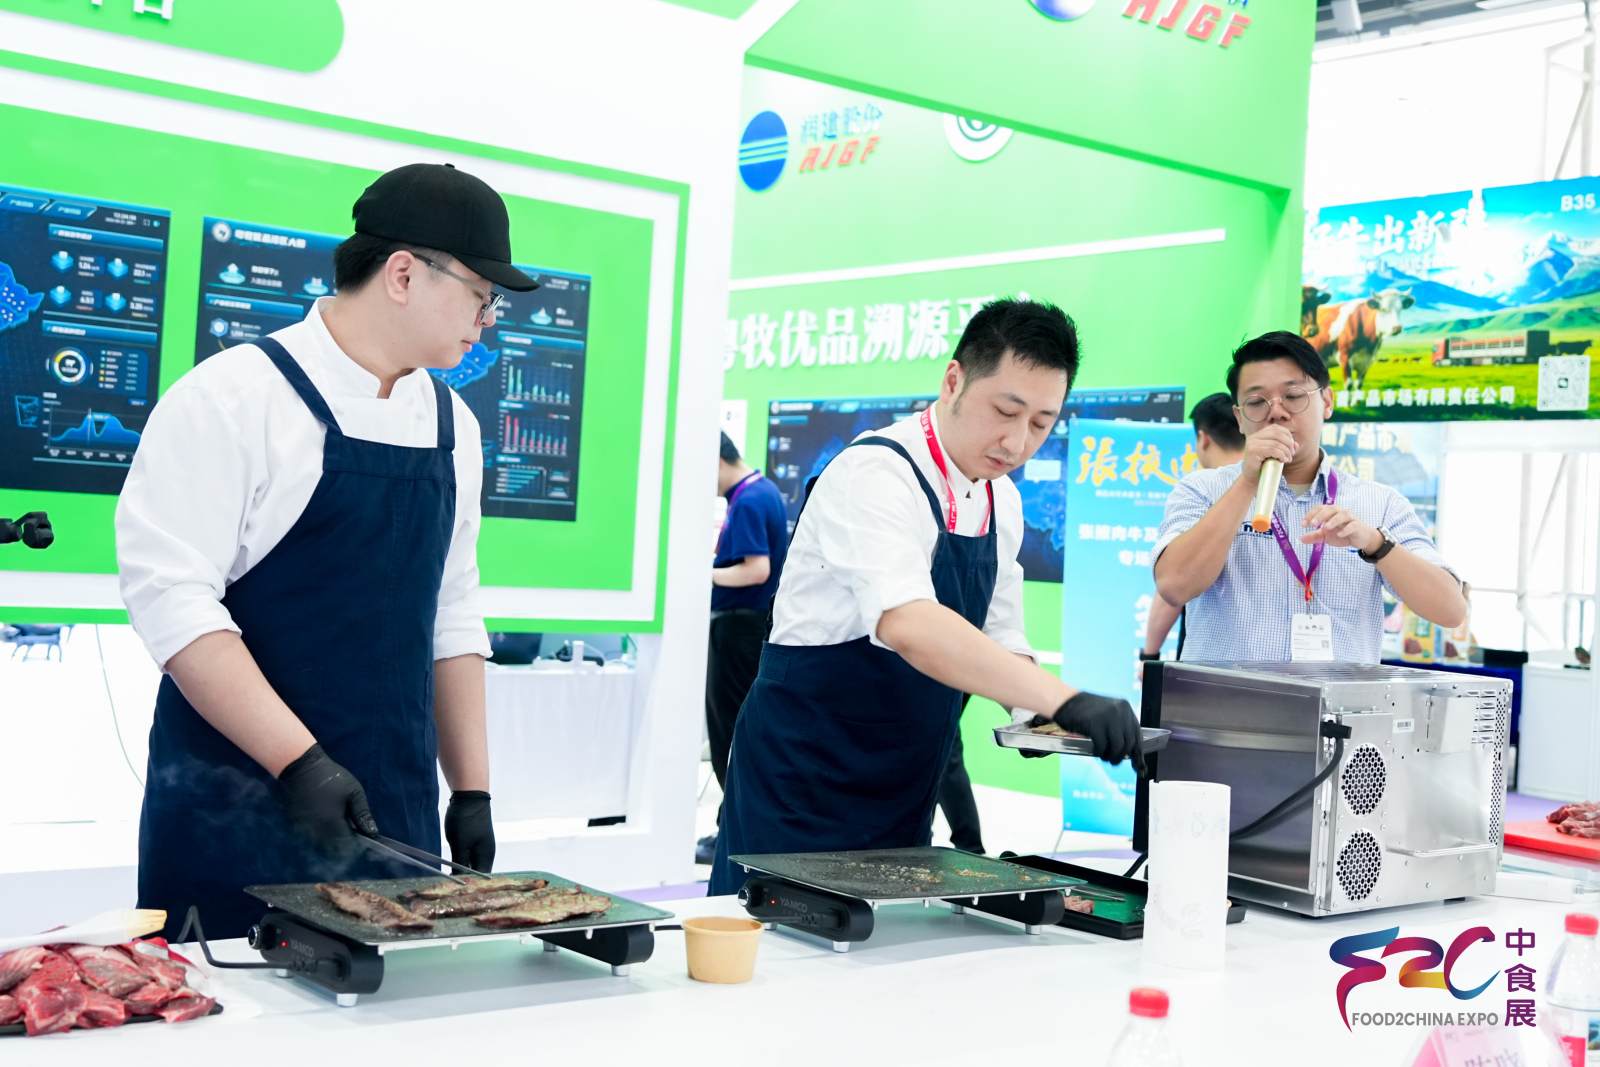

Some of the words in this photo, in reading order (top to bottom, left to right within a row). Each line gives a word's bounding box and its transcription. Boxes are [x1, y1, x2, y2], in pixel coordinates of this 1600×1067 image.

[1561, 193, 1597, 212] B35
[779, 896, 808, 913] YAMCO
[290, 938, 315, 958] YAMCO
